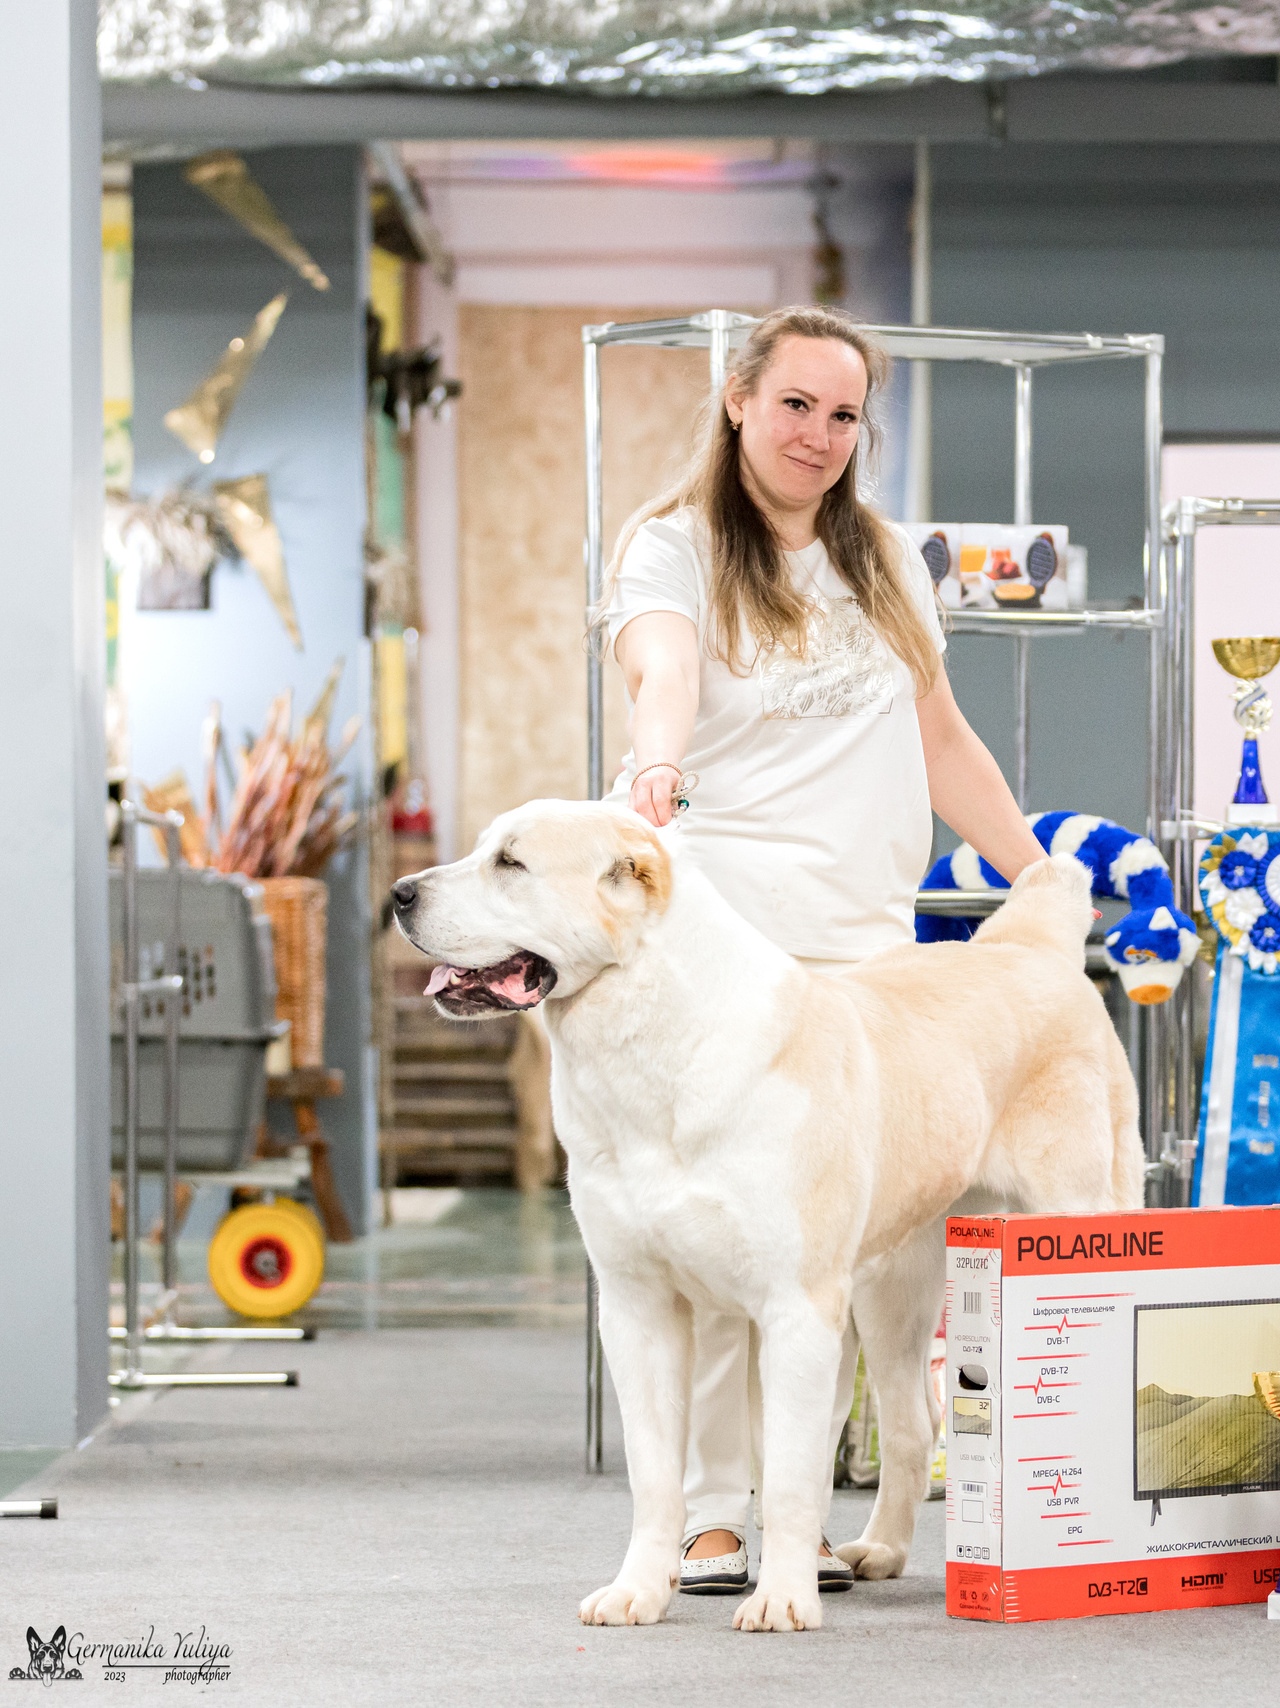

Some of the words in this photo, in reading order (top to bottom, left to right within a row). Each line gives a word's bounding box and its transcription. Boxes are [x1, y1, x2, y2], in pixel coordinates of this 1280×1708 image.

[950, 1226, 995, 1238] POLARLINE
[1017, 1231, 1164, 1262] POLARLINE
[956, 1257, 989, 1270] 32PL12TC
[1032, 1306, 1070, 1317] Цифровое
[1071, 1305, 1115, 1314] телевидение
[1046, 1336, 1070, 1346] DVB-T
[1040, 1366, 1069, 1376] DVB-T2
[1036, 1395, 1060, 1405] DVB-C
[1032, 1469, 1059, 1478] MPEG4
[1061, 1467, 1082, 1477] H.264
[1046, 1498, 1062, 1507] USB
[1064, 1496, 1080, 1506] PVR
[1067, 1525, 1083, 1535] EPG
[1146, 1534, 1273, 1553] ЖИДКОКРИСТАЛЛИЧЕСКИЙ
[1181, 1573, 1224, 1588] HDMI
